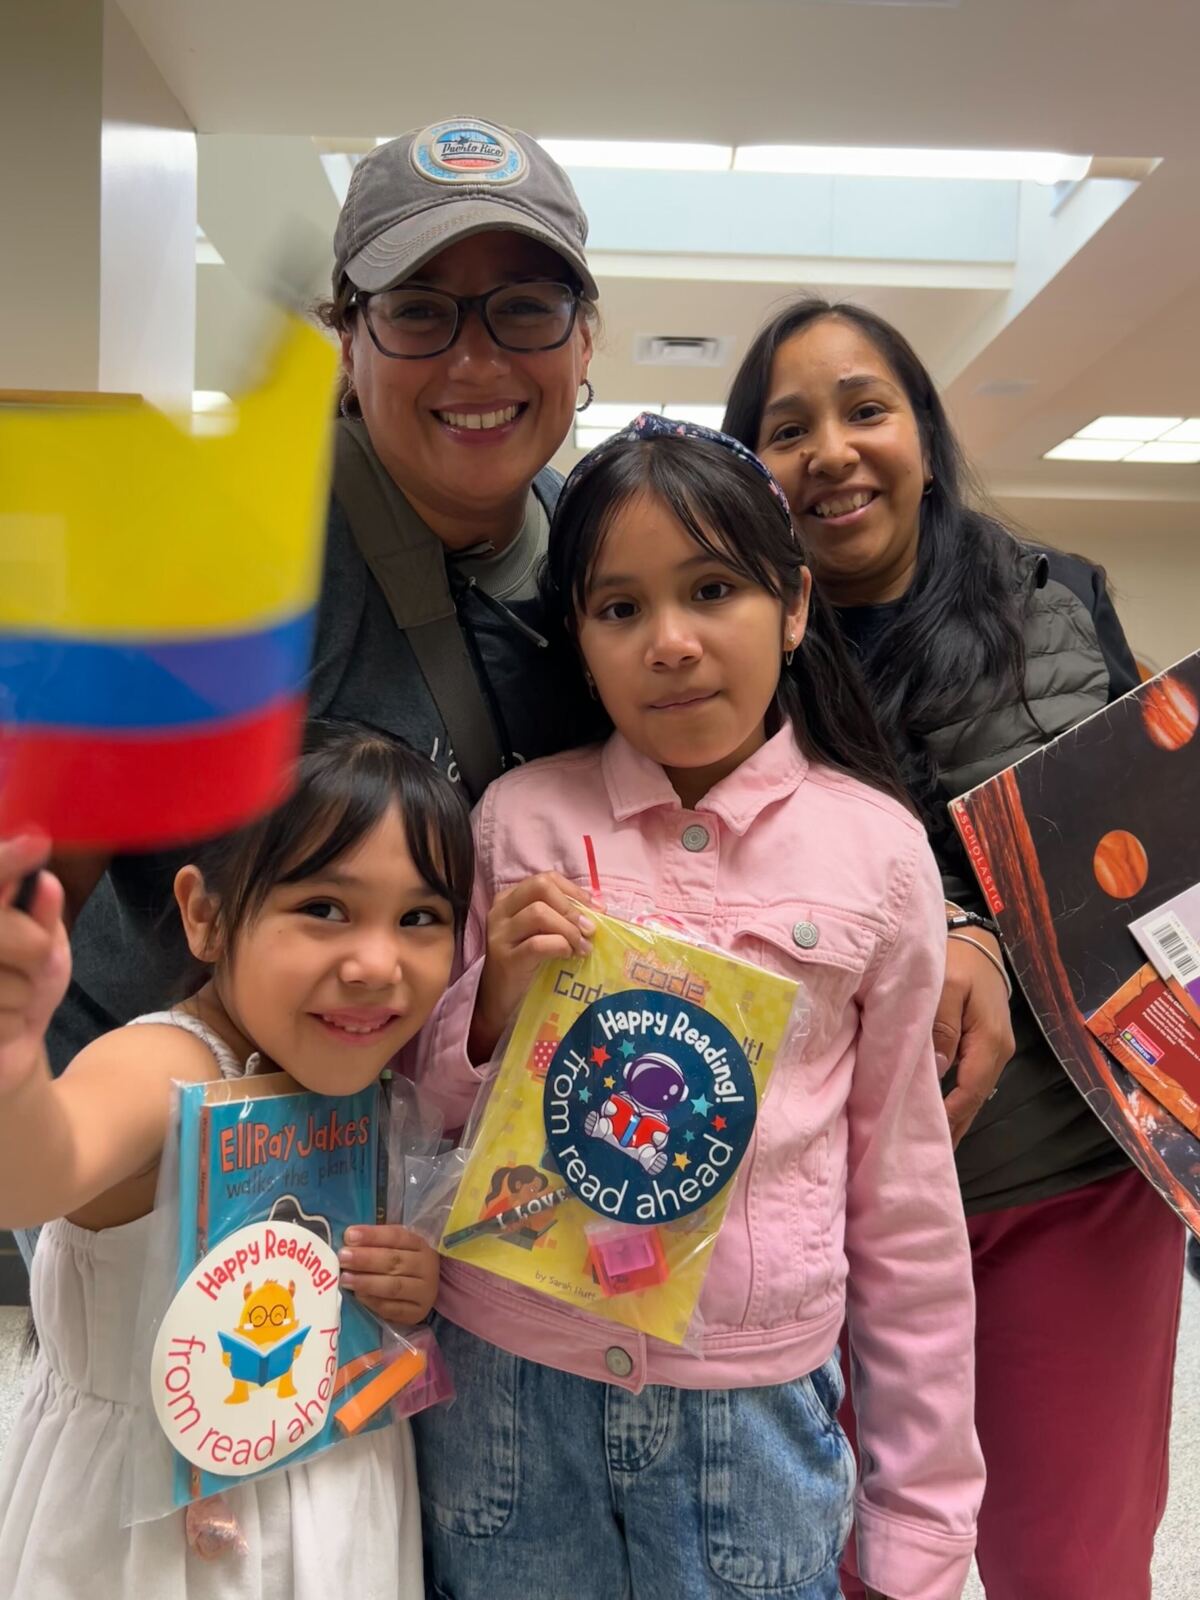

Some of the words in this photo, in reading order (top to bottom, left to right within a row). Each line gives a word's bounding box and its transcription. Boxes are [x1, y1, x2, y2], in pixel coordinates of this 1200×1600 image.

[442, 142, 478, 154] Puerto
[480, 144, 500, 157] Rico
[960, 814, 1003, 913] SCHOLASTIC
[597, 1009, 669, 1040] Happy
[669, 1011, 745, 1104] Reading!
[550, 1050, 590, 1135] from
[219, 1121, 297, 1175] EllRay
[296, 1110, 370, 1158] Jakes
[636, 1133, 734, 1219] ahead
[226, 1168, 275, 1199] walks
[284, 1167, 309, 1187] the
[495, 1212, 507, 1230] I
[514, 1187, 569, 1220] LOVE
[558, 1145, 629, 1215] read
[196, 1241, 261, 1301] Happy
[264, 1229, 338, 1296] Reading!
[535, 1270, 547, 1283] by
[549, 1276, 573, 1292] Sarah
[165, 1335, 207, 1434] from
[197, 1419, 276, 1466] read
